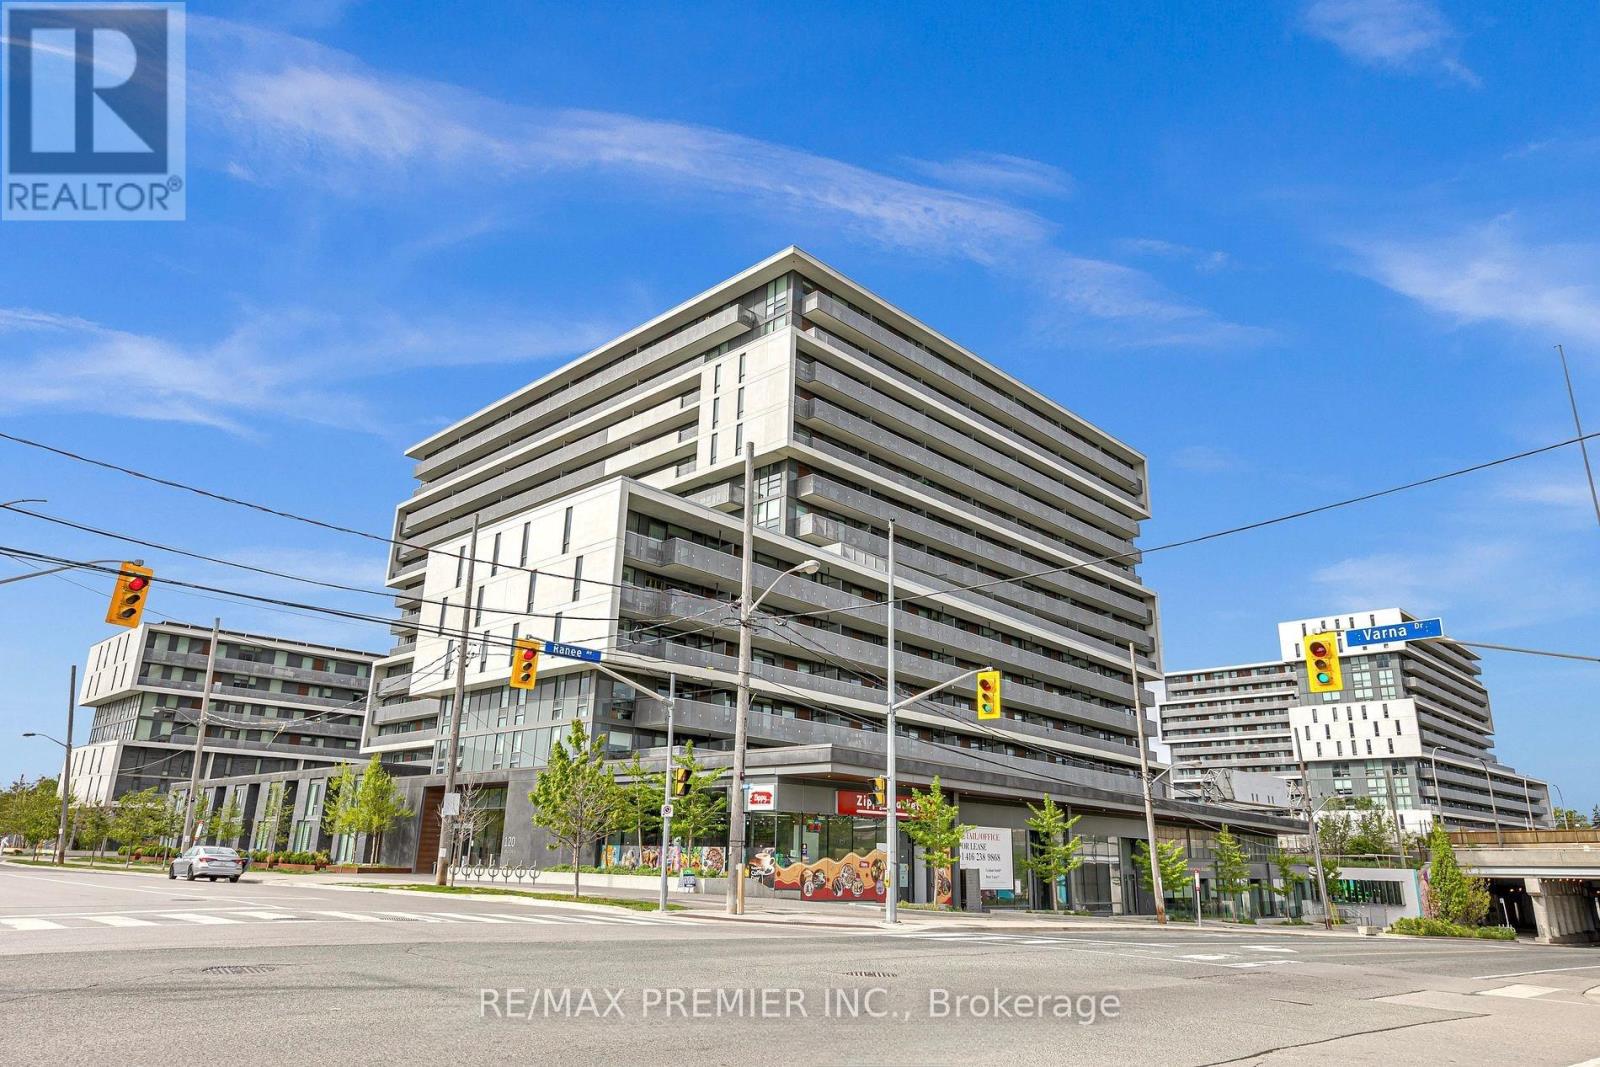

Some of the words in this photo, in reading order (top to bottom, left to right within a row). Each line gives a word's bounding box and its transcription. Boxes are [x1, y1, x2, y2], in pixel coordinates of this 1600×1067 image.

[1363, 627, 1407, 640] Varna
[553, 643, 582, 657] Ranee
[856, 795, 884, 810] Zip
[963, 832, 1000, 841] TAIL/OFFICE
[970, 843, 987, 851] LEASE
[965, 852, 975, 861] 416
